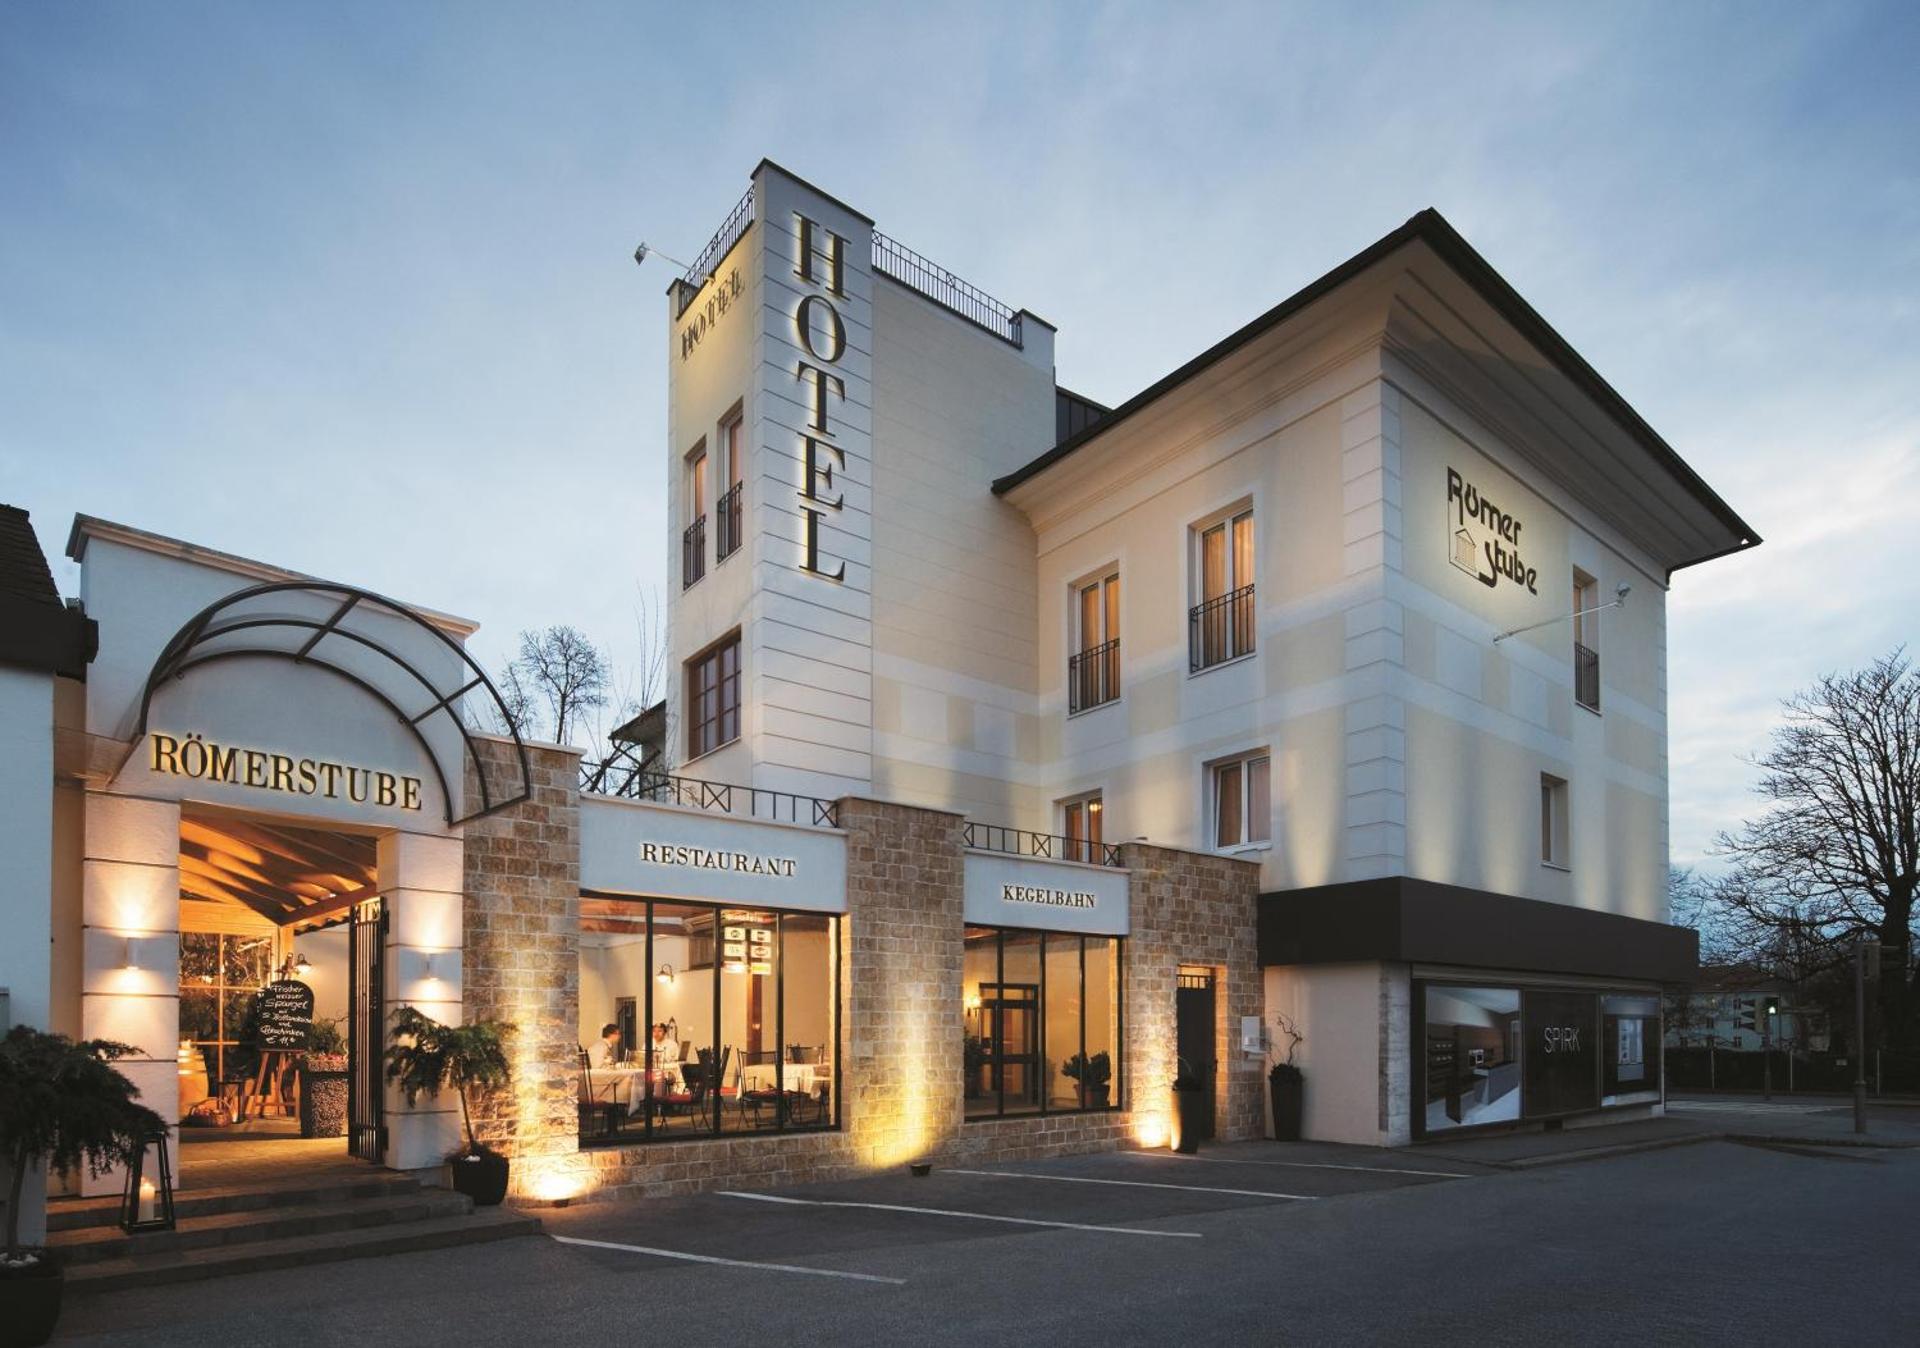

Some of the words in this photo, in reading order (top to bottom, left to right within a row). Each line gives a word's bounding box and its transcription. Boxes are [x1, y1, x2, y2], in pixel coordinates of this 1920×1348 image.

[681, 266, 746, 363] HOTEL
[793, 210, 852, 582] HOTEL
[1447, 465, 1522, 546] Römer
[1478, 539, 1538, 596] Stube
[149, 732, 423, 811] RÖMERSTUBE
[640, 842, 797, 877] RESTAURANT
[1003, 885, 1096, 908] KEGELBAHN
